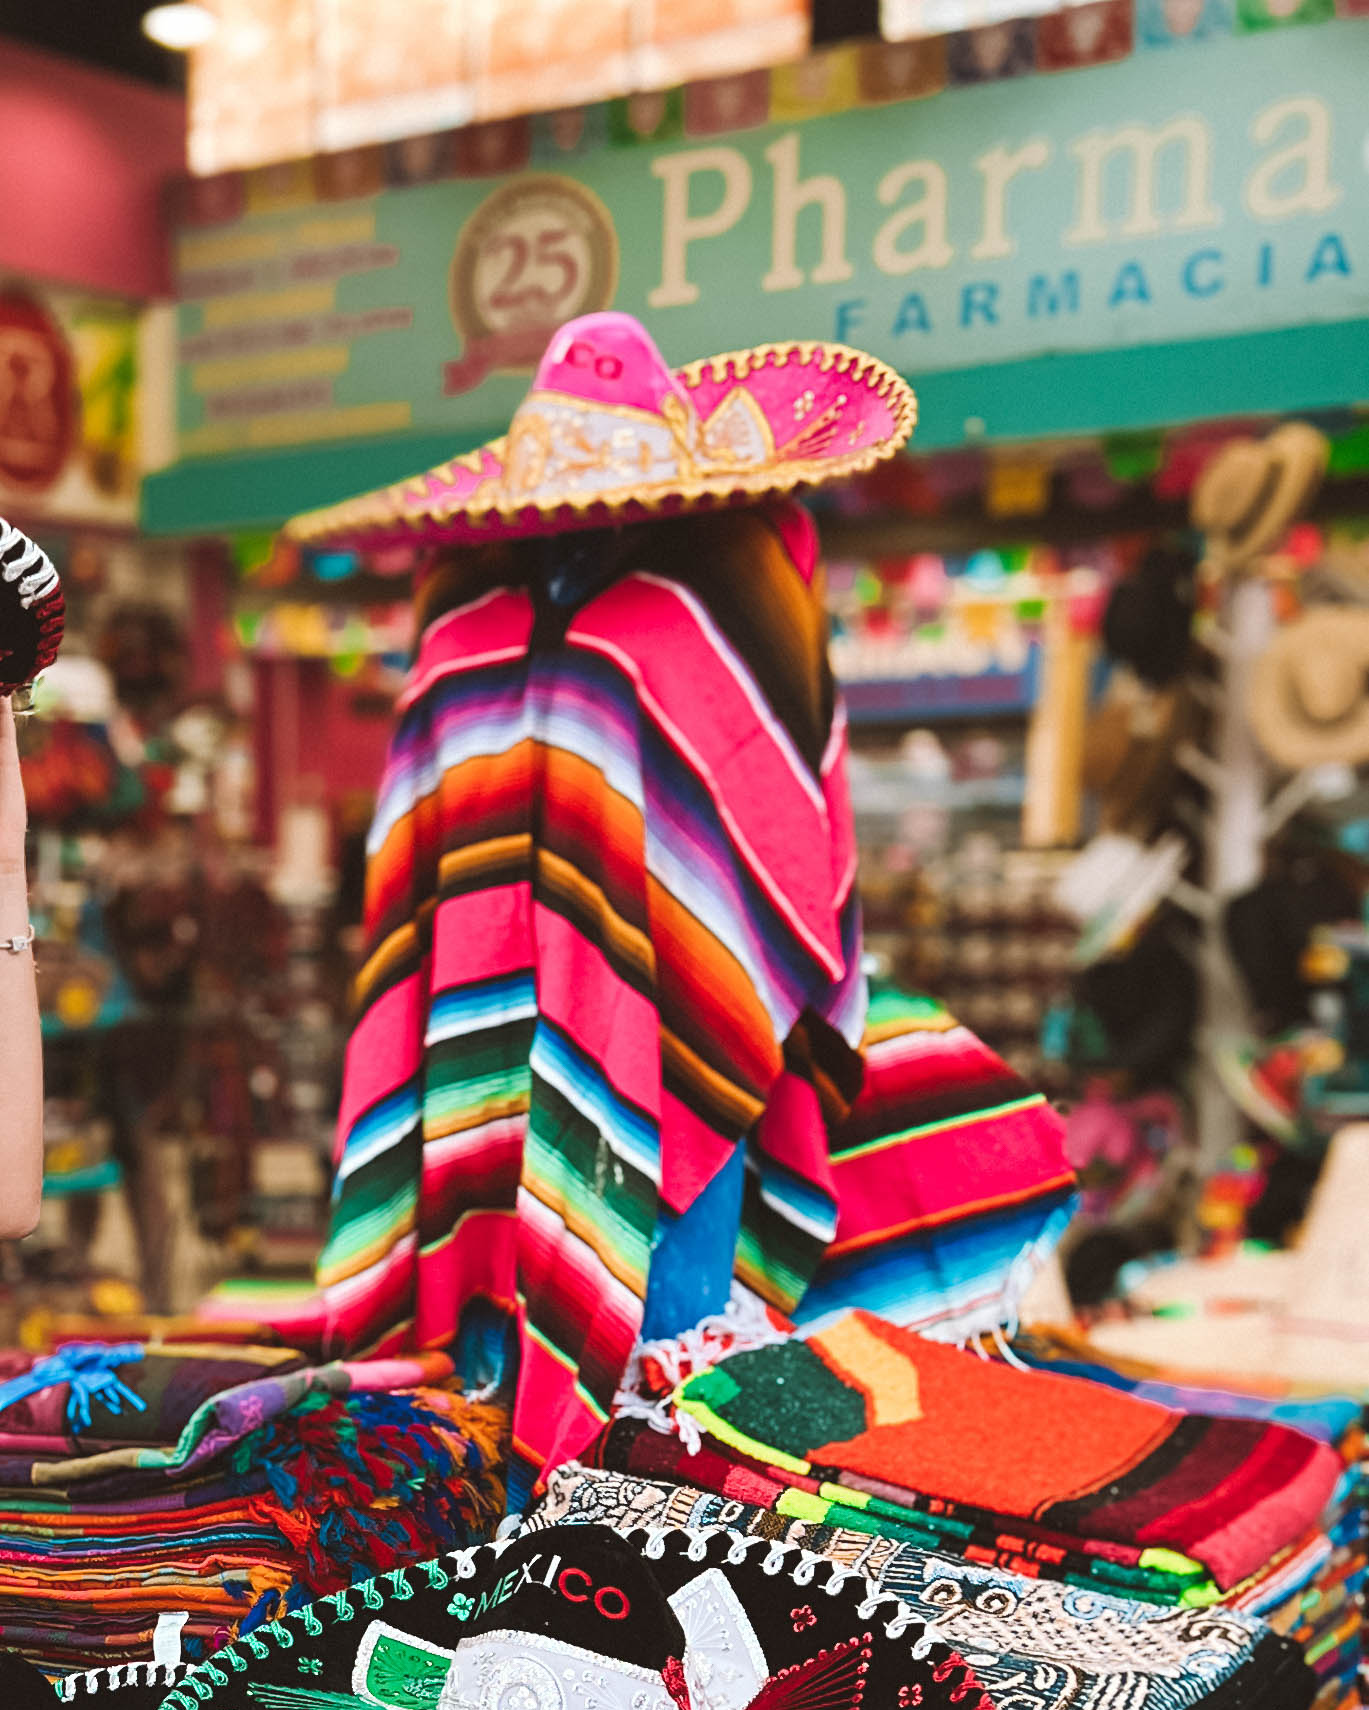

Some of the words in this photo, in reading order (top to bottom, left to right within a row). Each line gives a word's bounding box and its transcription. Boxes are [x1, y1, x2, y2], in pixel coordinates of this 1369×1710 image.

[646, 97, 1369, 309] Pharma
[482, 230, 579, 308] 25
[834, 232, 1353, 346] FARMACIA
[474, 1554, 631, 1620] MEXICO
